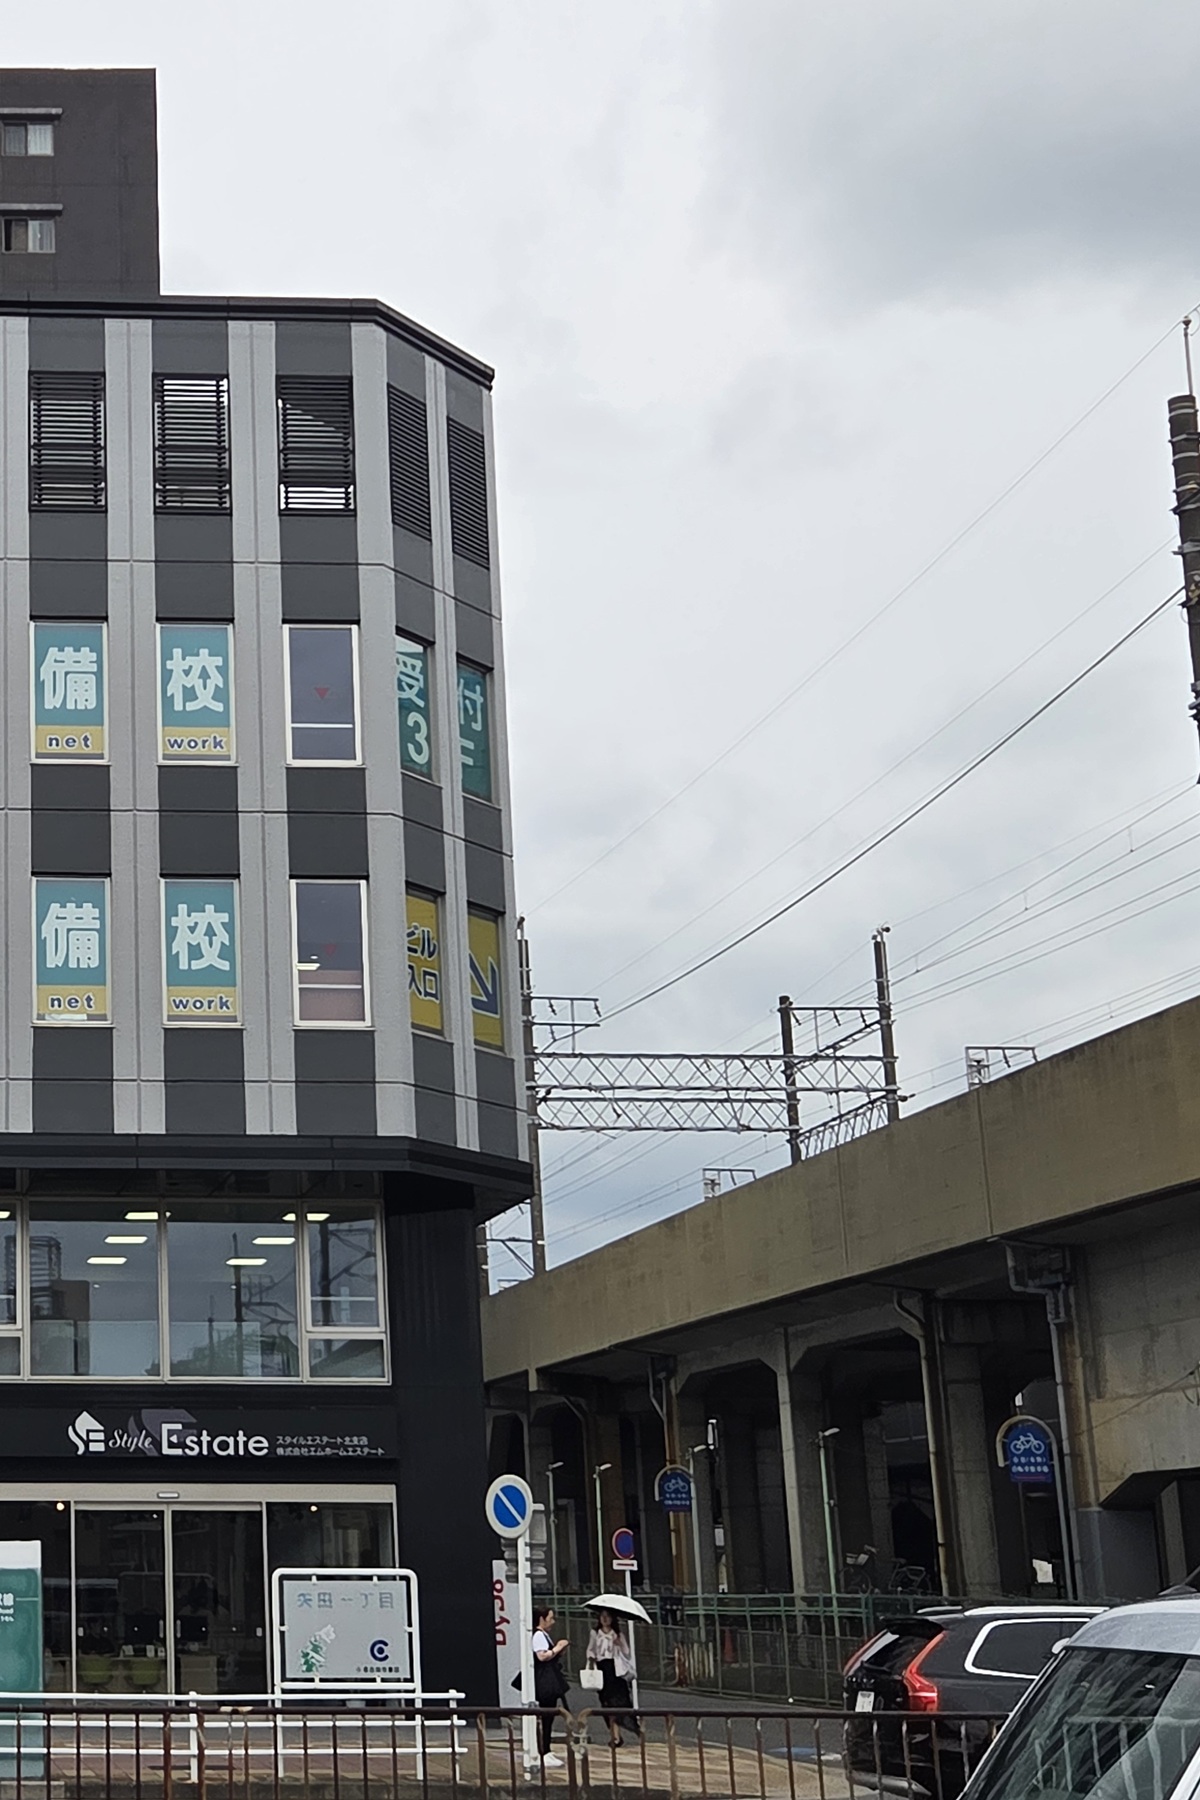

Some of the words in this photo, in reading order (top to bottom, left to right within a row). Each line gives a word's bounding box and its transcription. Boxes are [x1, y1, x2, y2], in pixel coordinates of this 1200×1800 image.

[47, 734, 92, 749] net
[166, 734, 225, 750] work
[49, 994, 94, 1009] net
[172, 994, 232, 1011] work
[108, 1428, 153, 1453] Style
[161, 1423, 269, 1456] Estate
